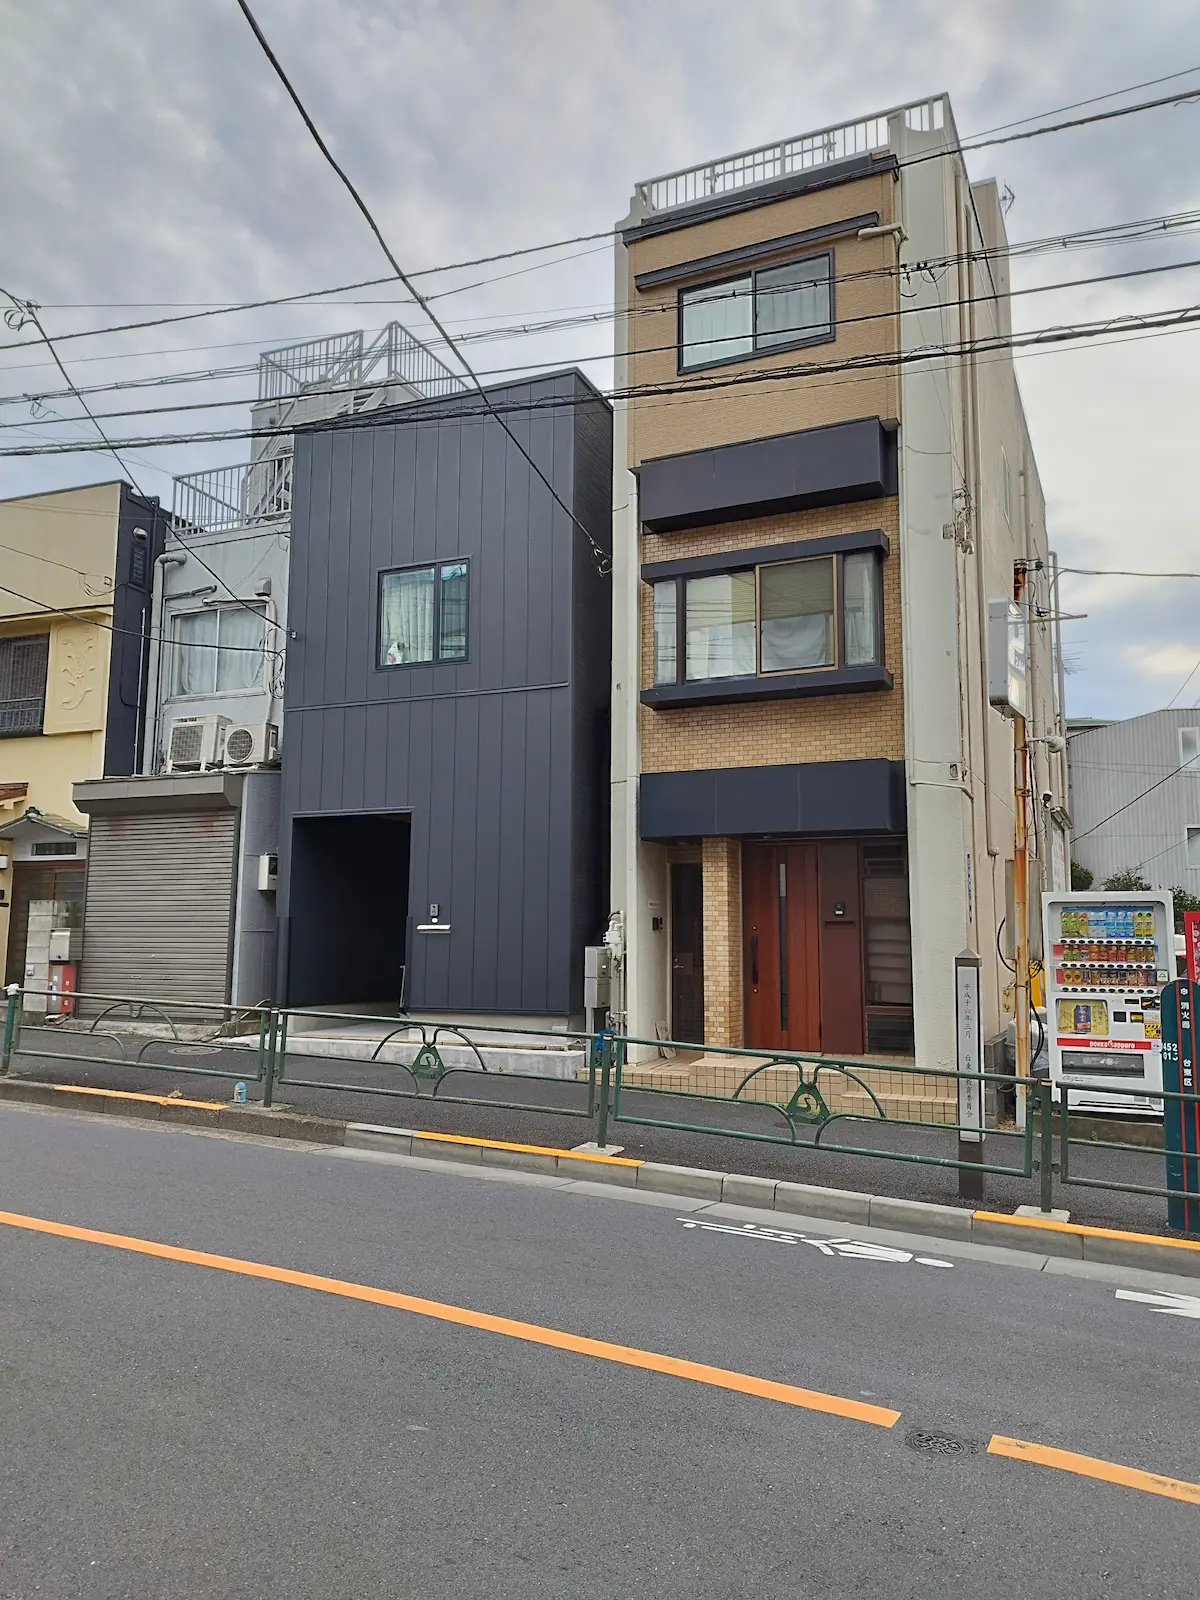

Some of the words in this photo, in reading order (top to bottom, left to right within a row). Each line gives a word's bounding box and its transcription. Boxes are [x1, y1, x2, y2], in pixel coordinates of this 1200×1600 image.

[963, 983, 972, 1039] 平成十六年三月
[1180, 1001, 1190, 1029] 消火器
[964, 1054, 974, 1118] 台東教育委員会
[1183, 1058, 1192, 1087] 台東区
